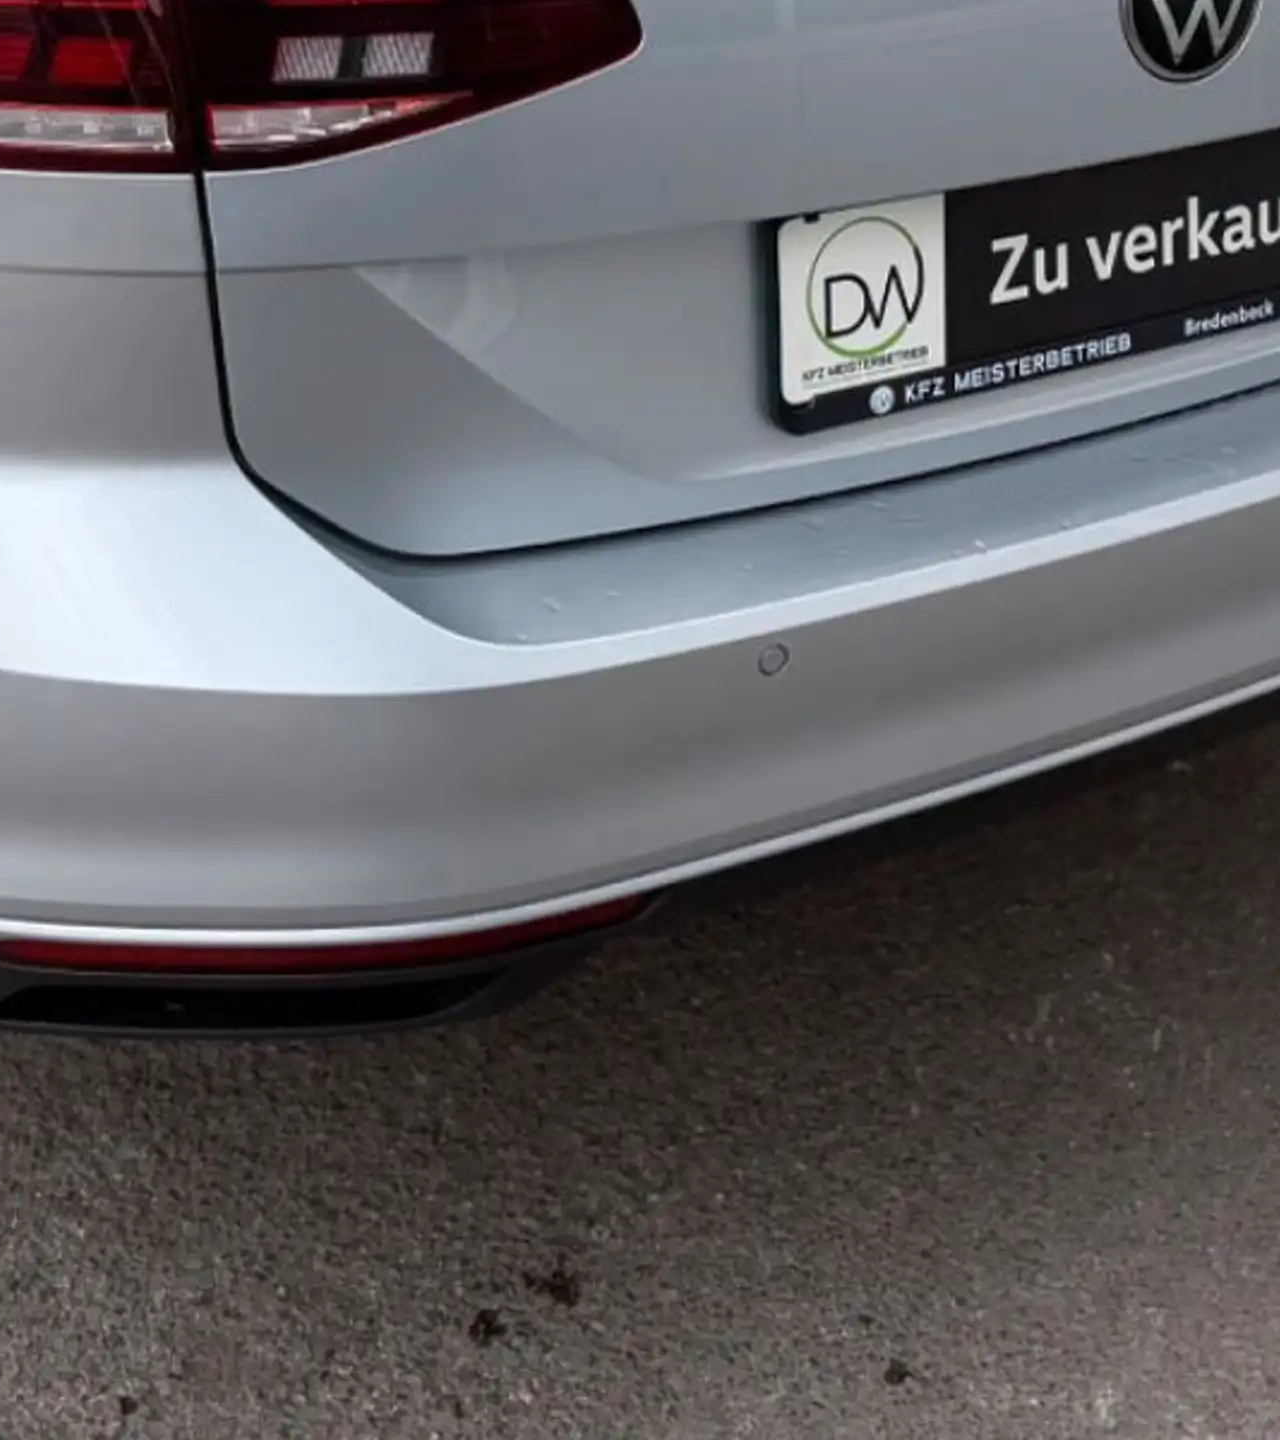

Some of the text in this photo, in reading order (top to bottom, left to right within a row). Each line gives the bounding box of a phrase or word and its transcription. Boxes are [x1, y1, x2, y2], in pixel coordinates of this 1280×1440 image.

[990, 233, 1068, 305] Zu
[1184, 298, 1274, 337] Bredenbeck
[904, 377, 946, 404] KFZ
[954, 332, 1132, 391] MEISTERBETRIEB
